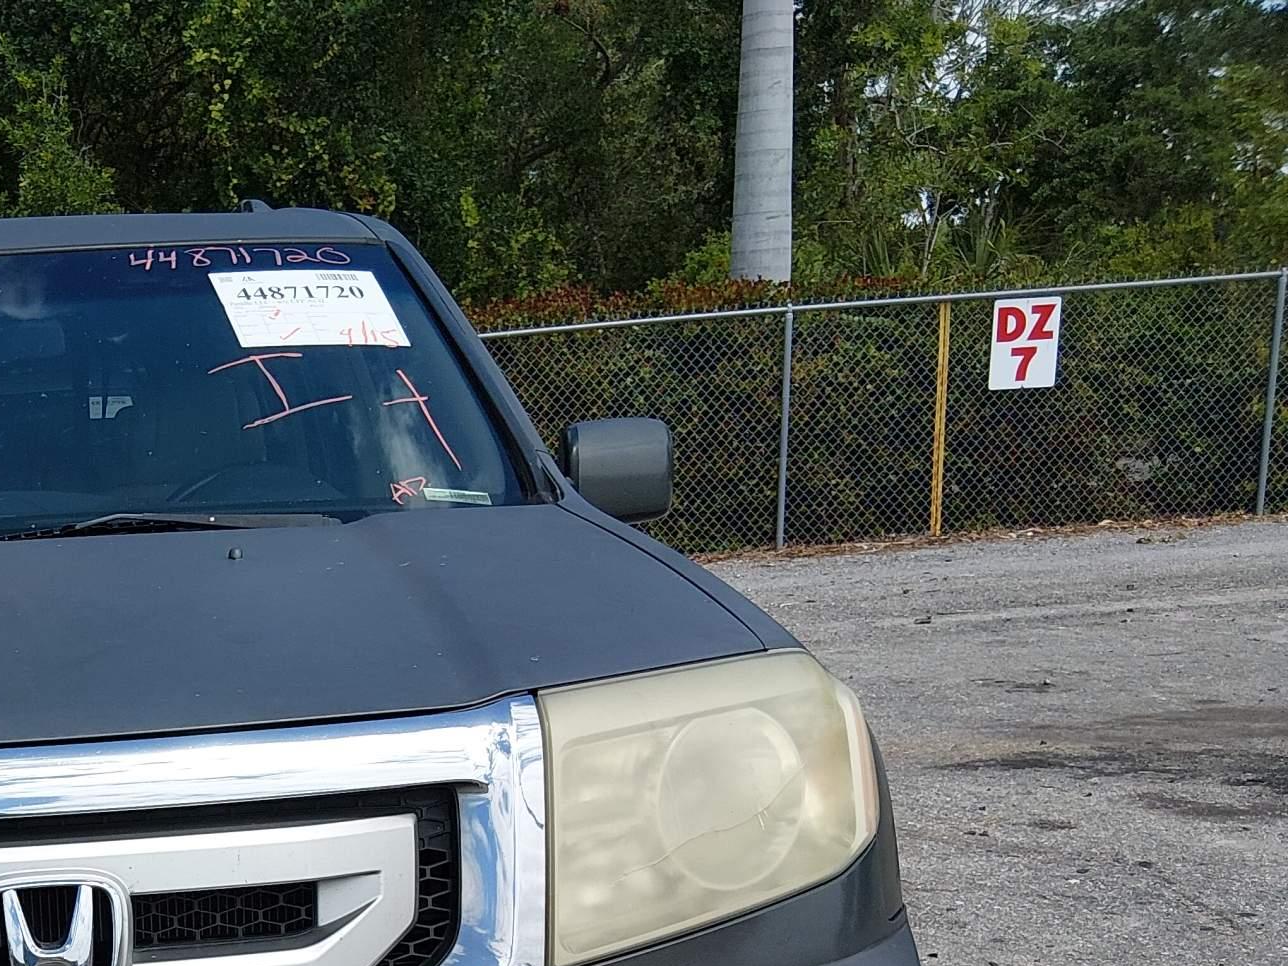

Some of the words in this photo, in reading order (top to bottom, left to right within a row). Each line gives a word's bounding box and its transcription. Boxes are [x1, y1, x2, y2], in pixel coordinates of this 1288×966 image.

[128, 246, 350, 271] 44871720
[236, 284, 365, 301] 44871720
[996, 303, 1057, 343] DZ
[1010, 346, 1038, 382] 7
